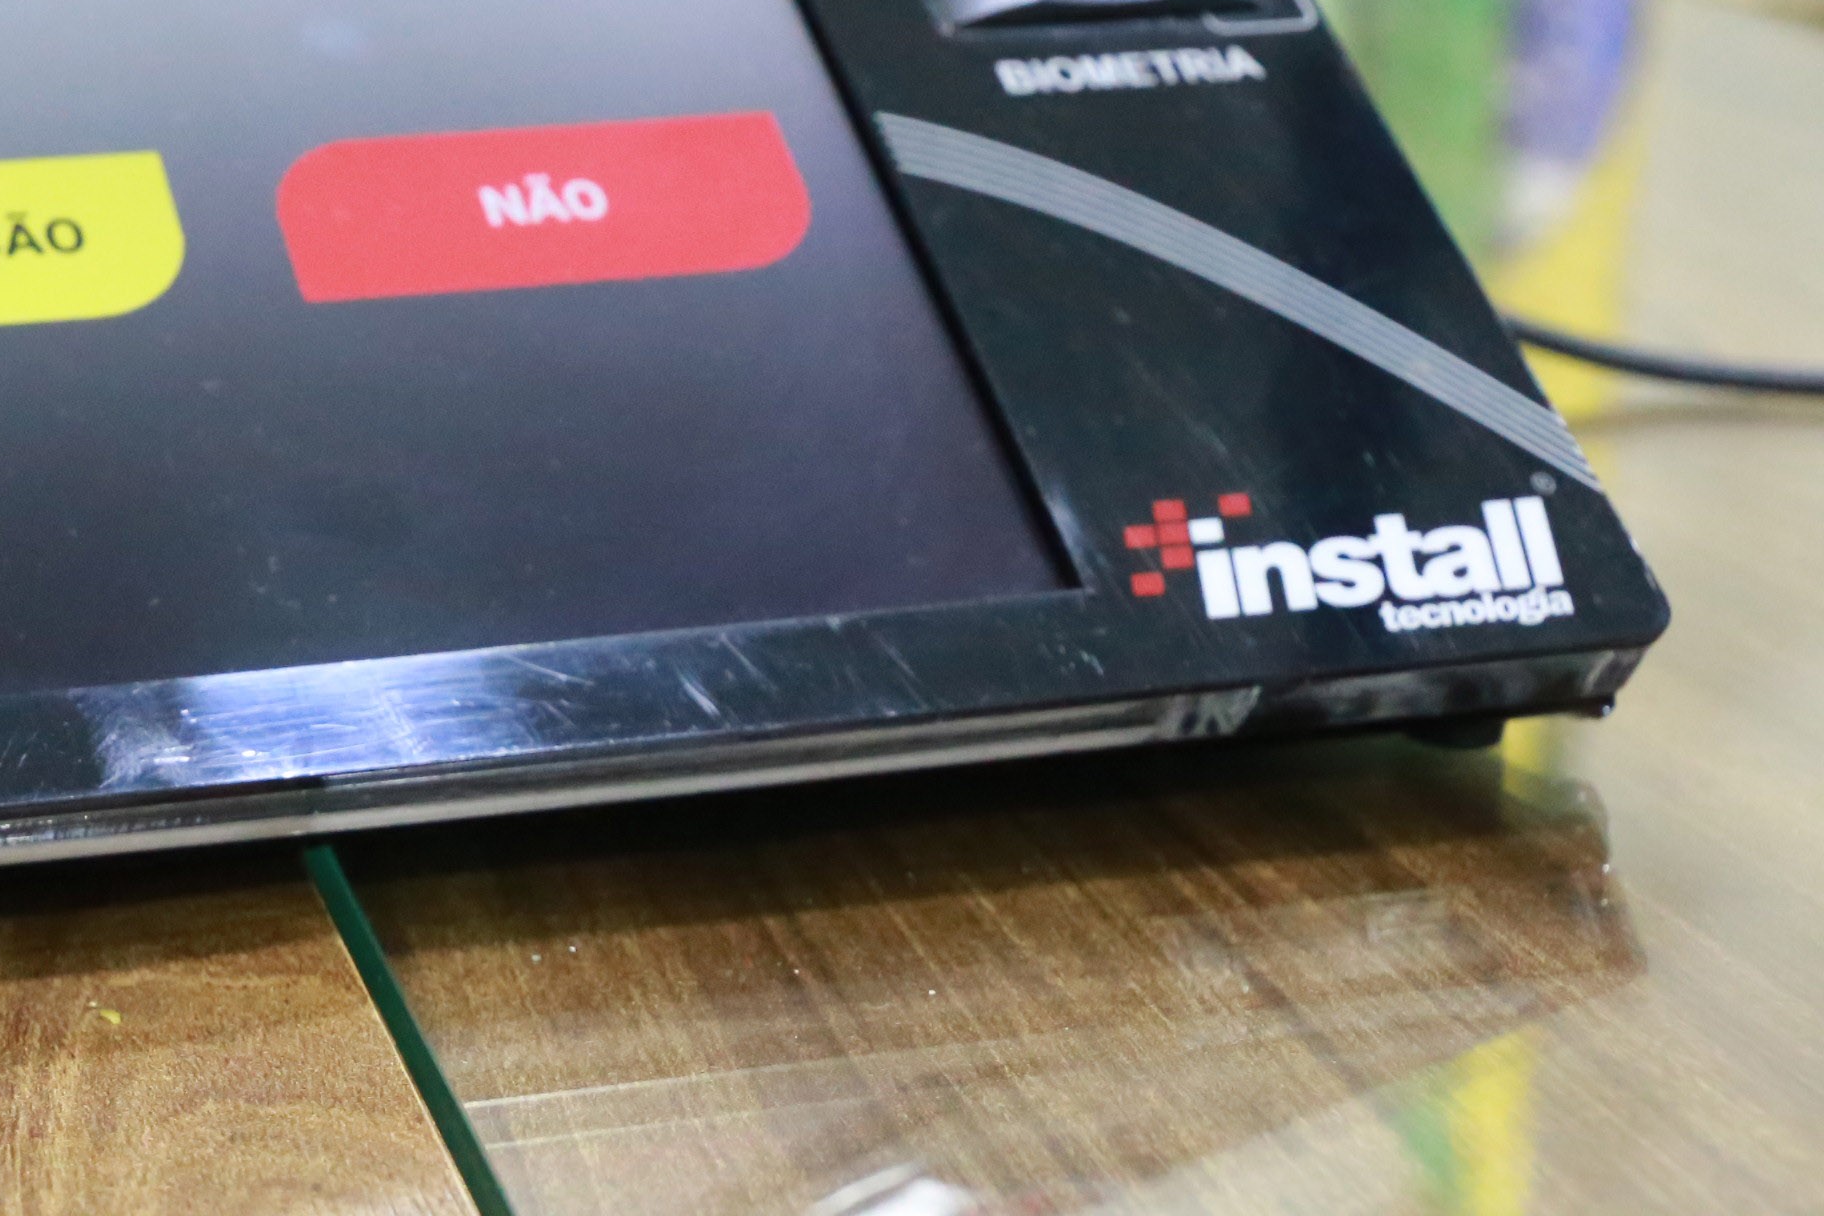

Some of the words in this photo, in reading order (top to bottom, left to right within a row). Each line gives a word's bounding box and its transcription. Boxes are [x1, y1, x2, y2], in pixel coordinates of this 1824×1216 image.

[994, 44, 1265, 96] BIOMETRIA
[478, 173, 608, 228] NÃO
[1188, 495, 1565, 619] install
[1379, 584, 1573, 632] tecnologia
